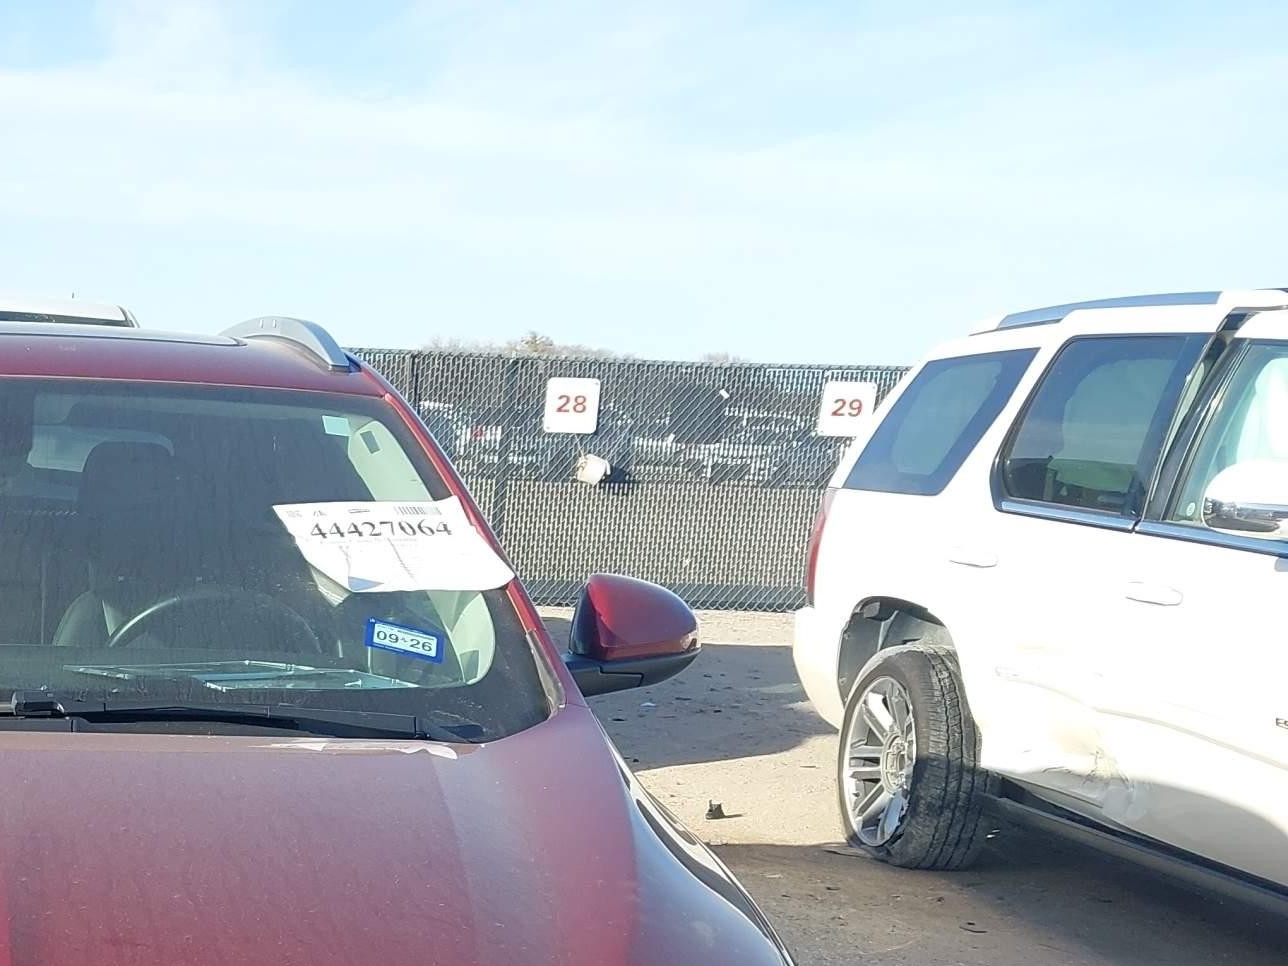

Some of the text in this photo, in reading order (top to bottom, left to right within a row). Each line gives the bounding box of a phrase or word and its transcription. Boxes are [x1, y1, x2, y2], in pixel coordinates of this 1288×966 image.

[556, 394, 587, 413] 28
[831, 398, 863, 417] 29
[310, 518, 453, 539] 44427064
